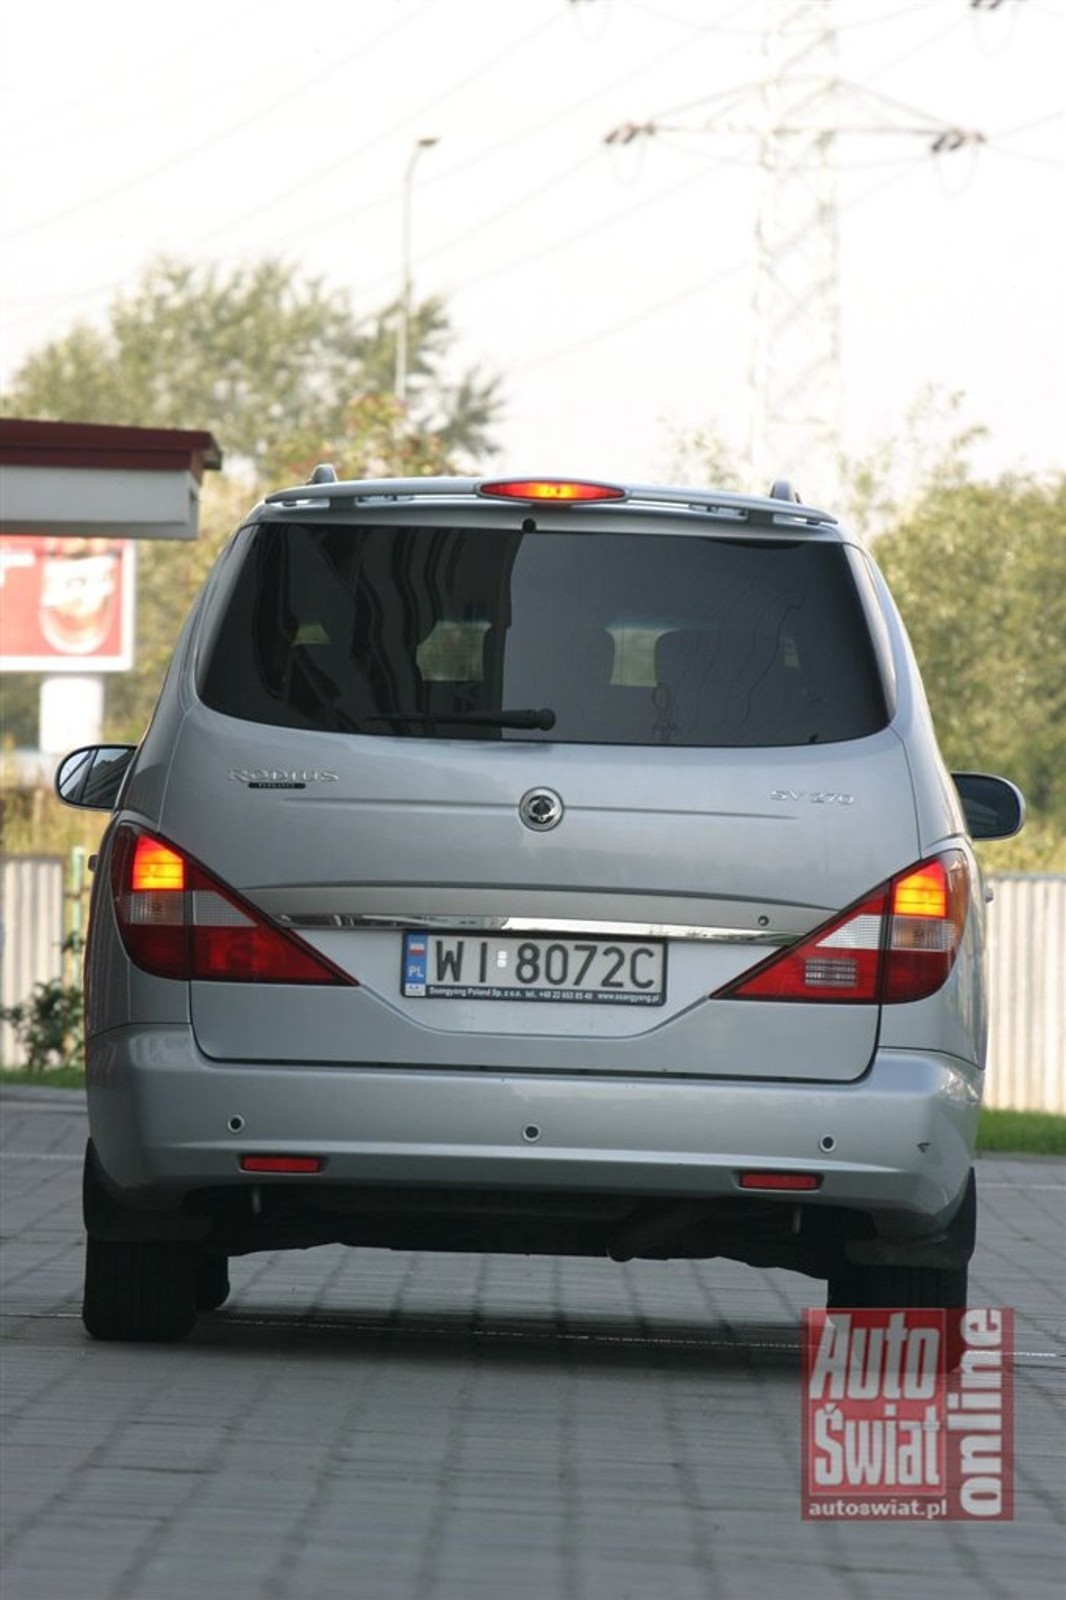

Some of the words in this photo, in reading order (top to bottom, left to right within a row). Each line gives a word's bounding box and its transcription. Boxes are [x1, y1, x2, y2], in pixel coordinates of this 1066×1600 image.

[768, 790, 804, 801] SV
[810, 793, 854, 805] 270
[409, 966, 425, 977] PL
[435, 940, 488, 983] WI
[515, 942, 655, 989] 8072C
